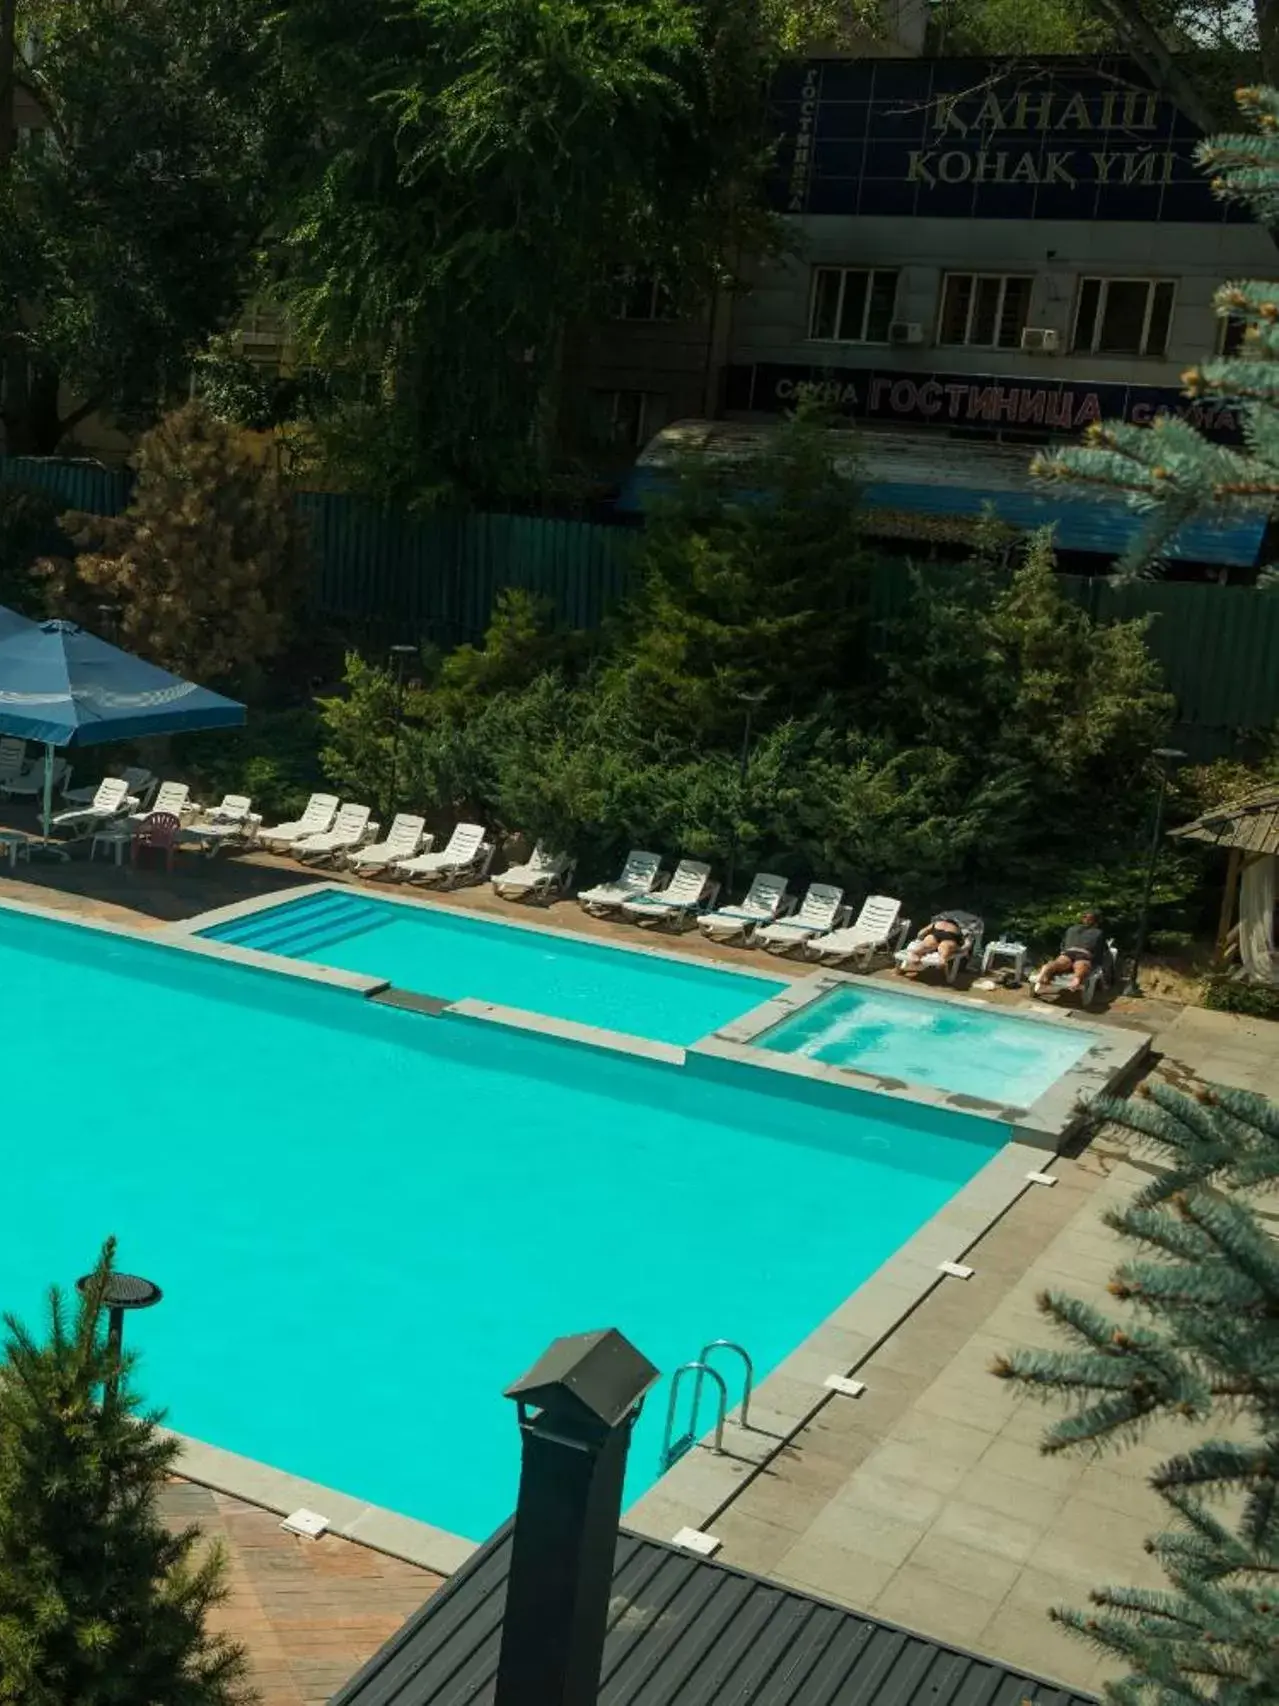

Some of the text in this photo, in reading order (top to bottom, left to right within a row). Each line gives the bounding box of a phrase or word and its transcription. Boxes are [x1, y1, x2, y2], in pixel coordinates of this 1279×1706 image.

[931, 91, 1158, 138] ҚАНАШ
[905, 150, 1075, 190] ҚОНАҚ
[870, 378, 1102, 429] ГОСТИНИЦА
